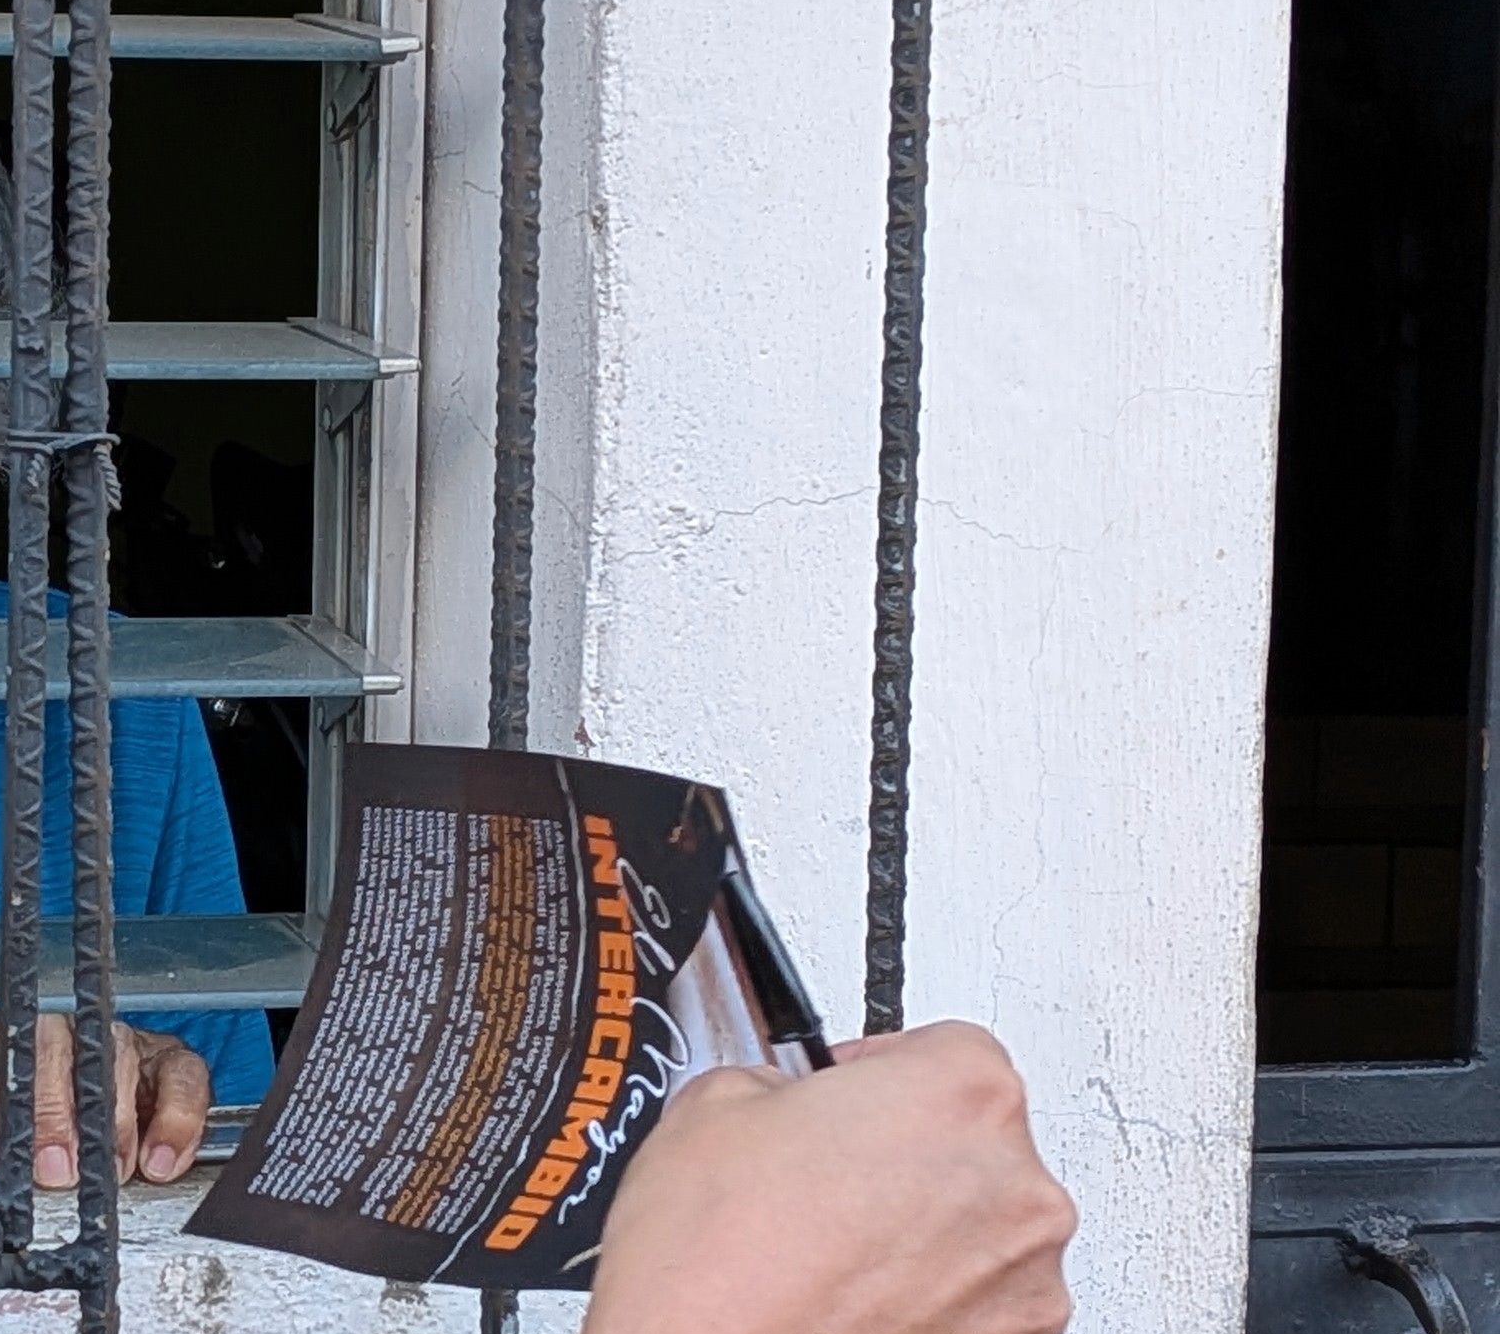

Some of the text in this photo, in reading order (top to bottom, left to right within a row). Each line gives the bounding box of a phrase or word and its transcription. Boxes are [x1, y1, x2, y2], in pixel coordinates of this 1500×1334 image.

[484, 814, 636, 1250] INTERCAMBIO
[558, 858, 690, 1224] El Mayor
